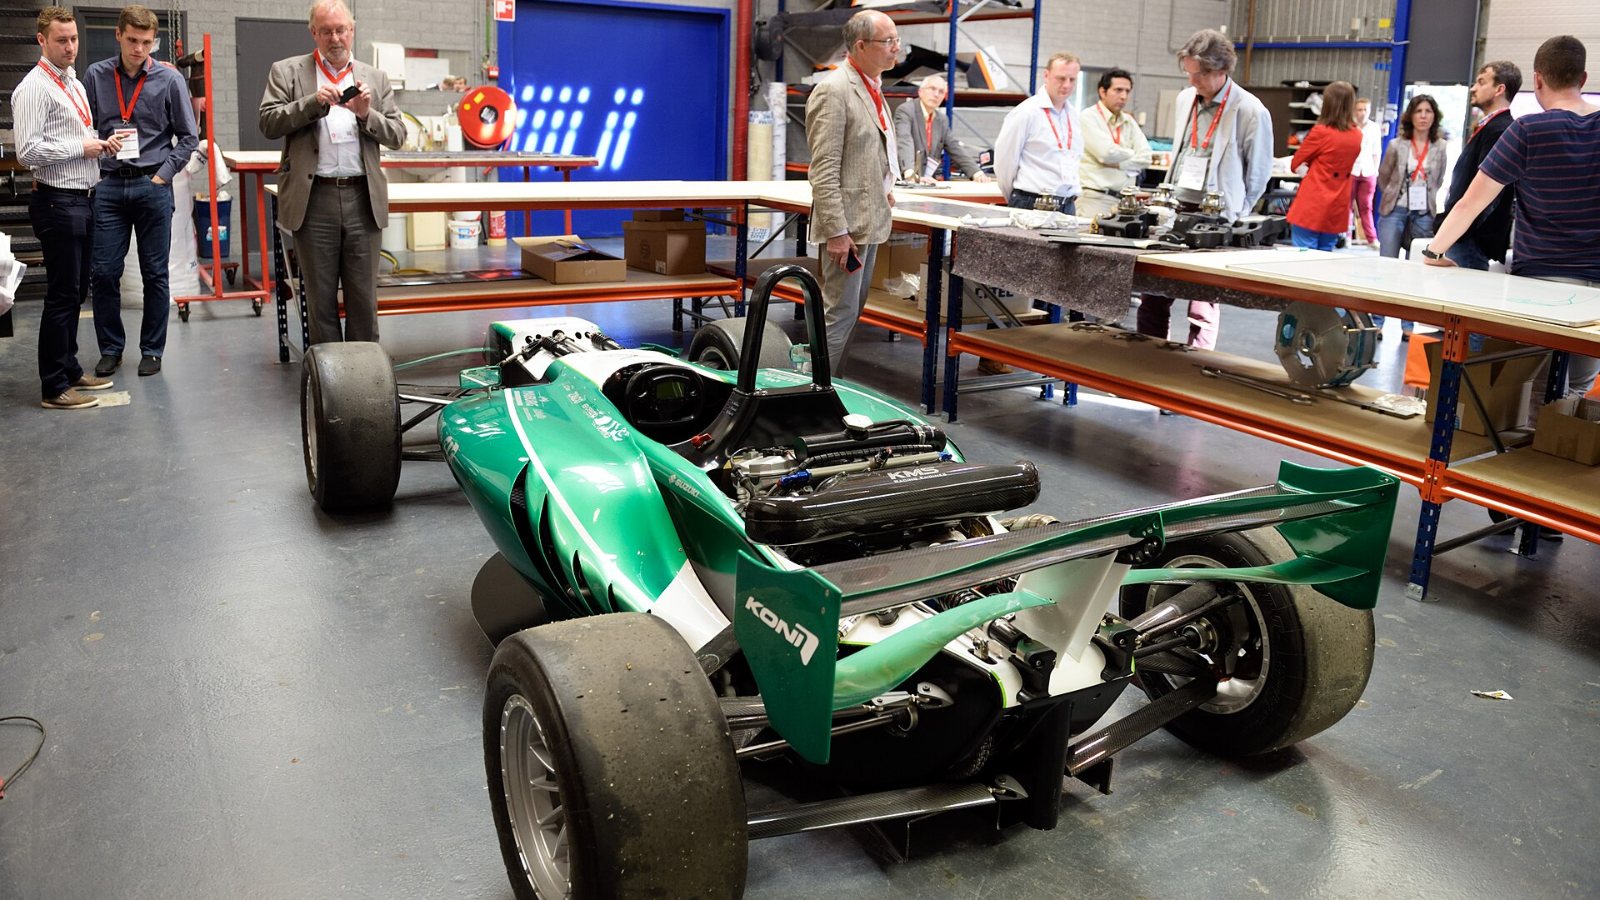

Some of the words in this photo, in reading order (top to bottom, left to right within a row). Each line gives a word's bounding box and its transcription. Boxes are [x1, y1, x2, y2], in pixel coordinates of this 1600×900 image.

[887, 467, 939, 480] KMS
[674, 478, 700, 497] SUZUKI
[745, 596, 819, 666] KONI
